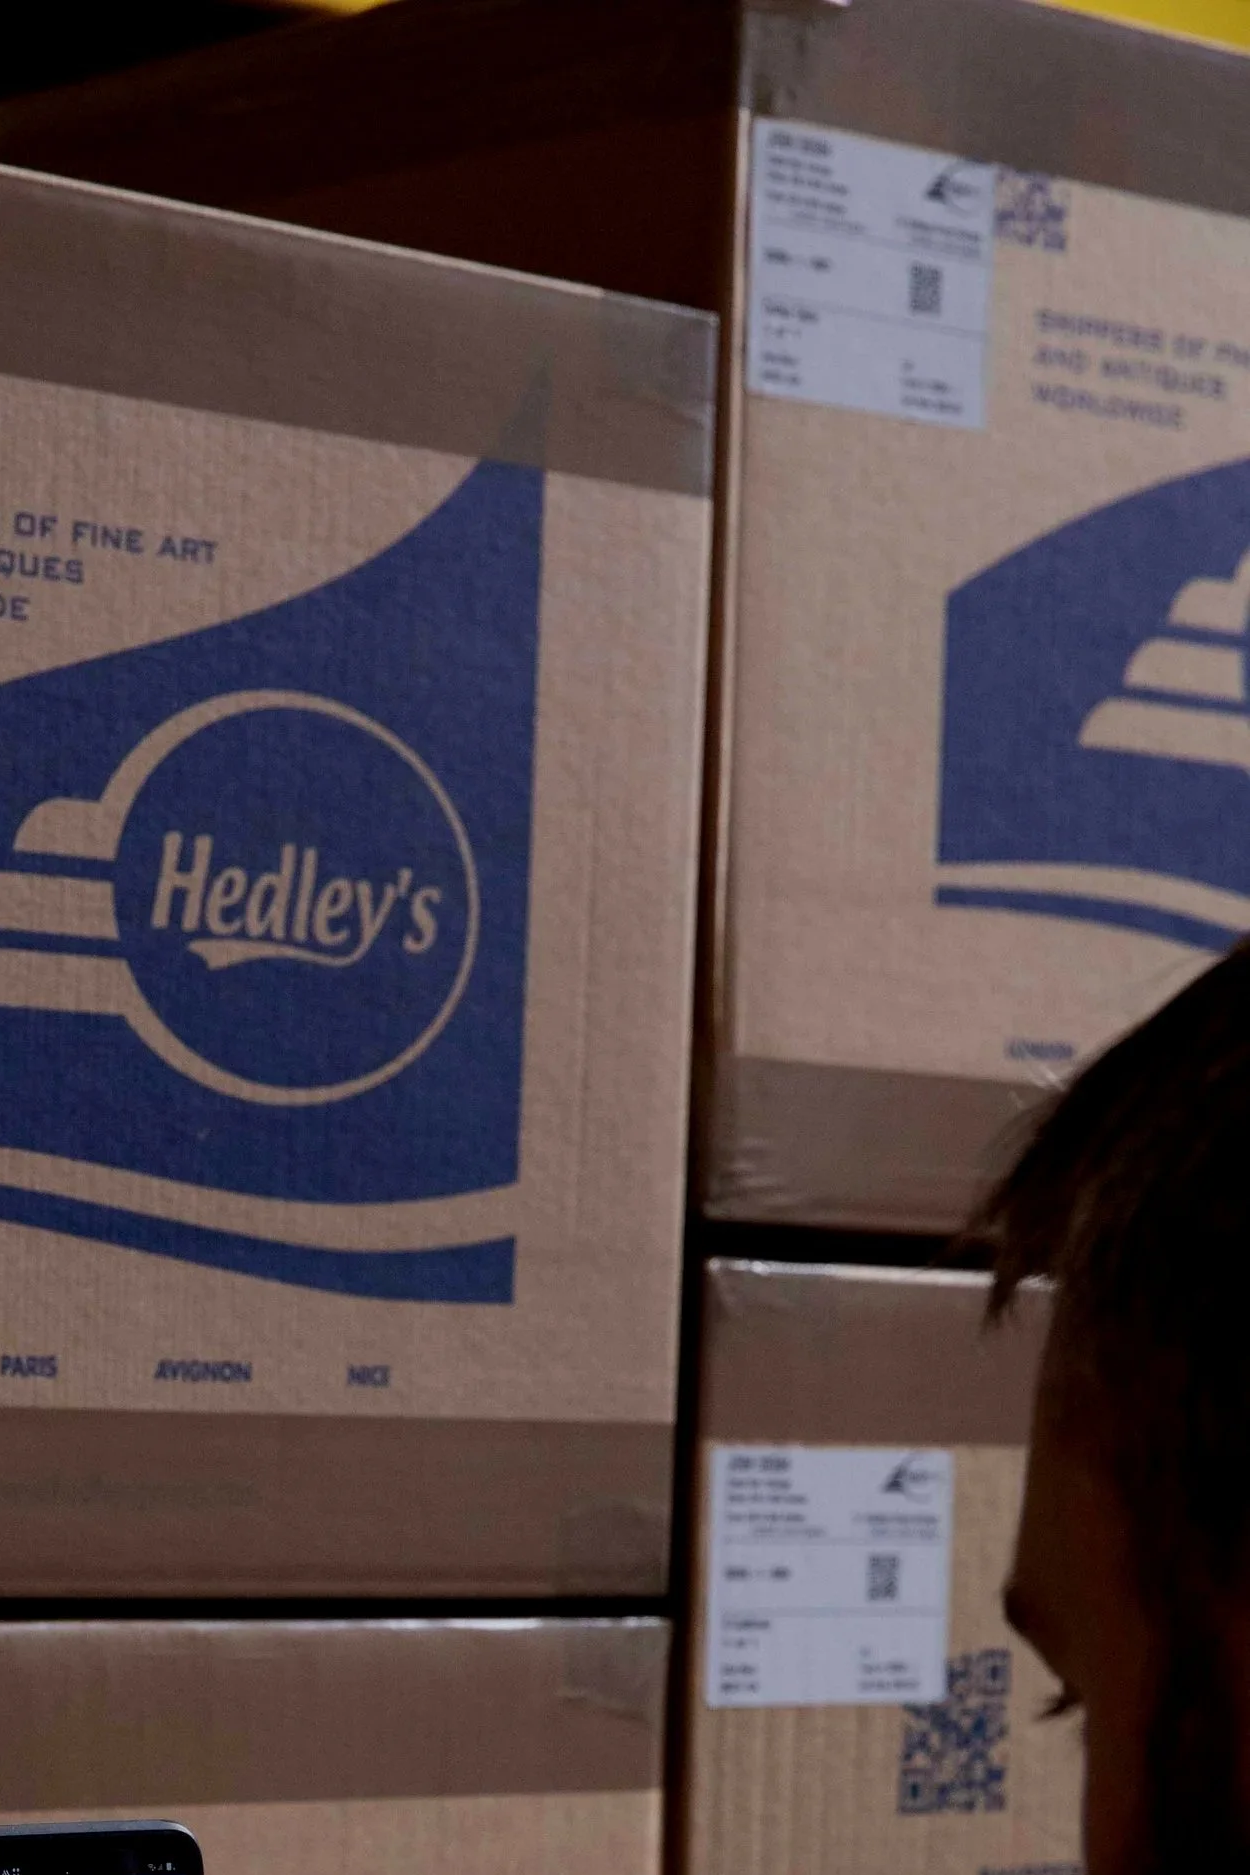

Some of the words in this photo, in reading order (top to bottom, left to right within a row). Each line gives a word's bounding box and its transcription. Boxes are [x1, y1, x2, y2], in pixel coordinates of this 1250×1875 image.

[12, 511, 59, 538] OF
[71, 520, 145, 554] FINE
[157, 535, 218, 565] ART
[151, 830, 443, 970] Hedley's
[0, 1354, 58, 1379] PARIS
[154, 1360, 252, 1383] AVIGNON
